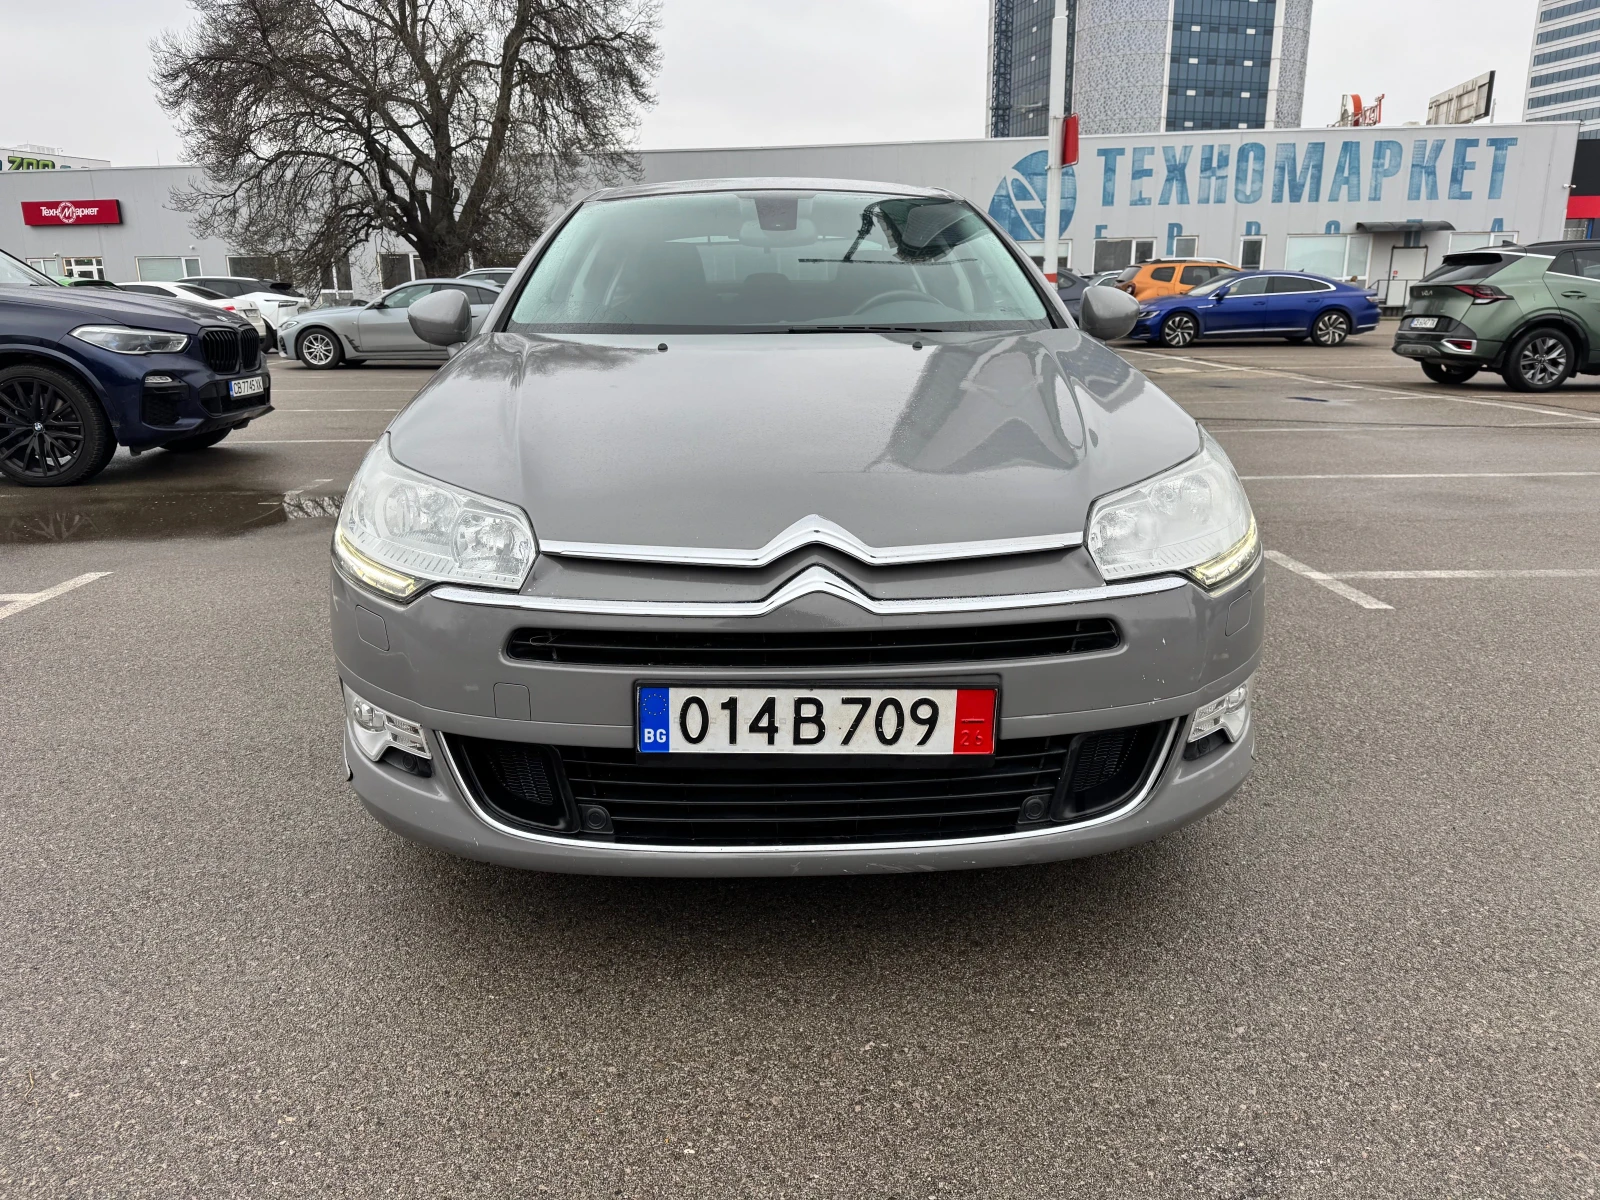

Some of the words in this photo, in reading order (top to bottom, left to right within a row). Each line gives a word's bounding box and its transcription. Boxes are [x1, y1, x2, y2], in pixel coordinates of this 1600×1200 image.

[1097, 138, 1518, 207] ТЕХНОМАРКЕТ
[643, 728, 667, 743] BG
[960, 729, 984, 746] 26
